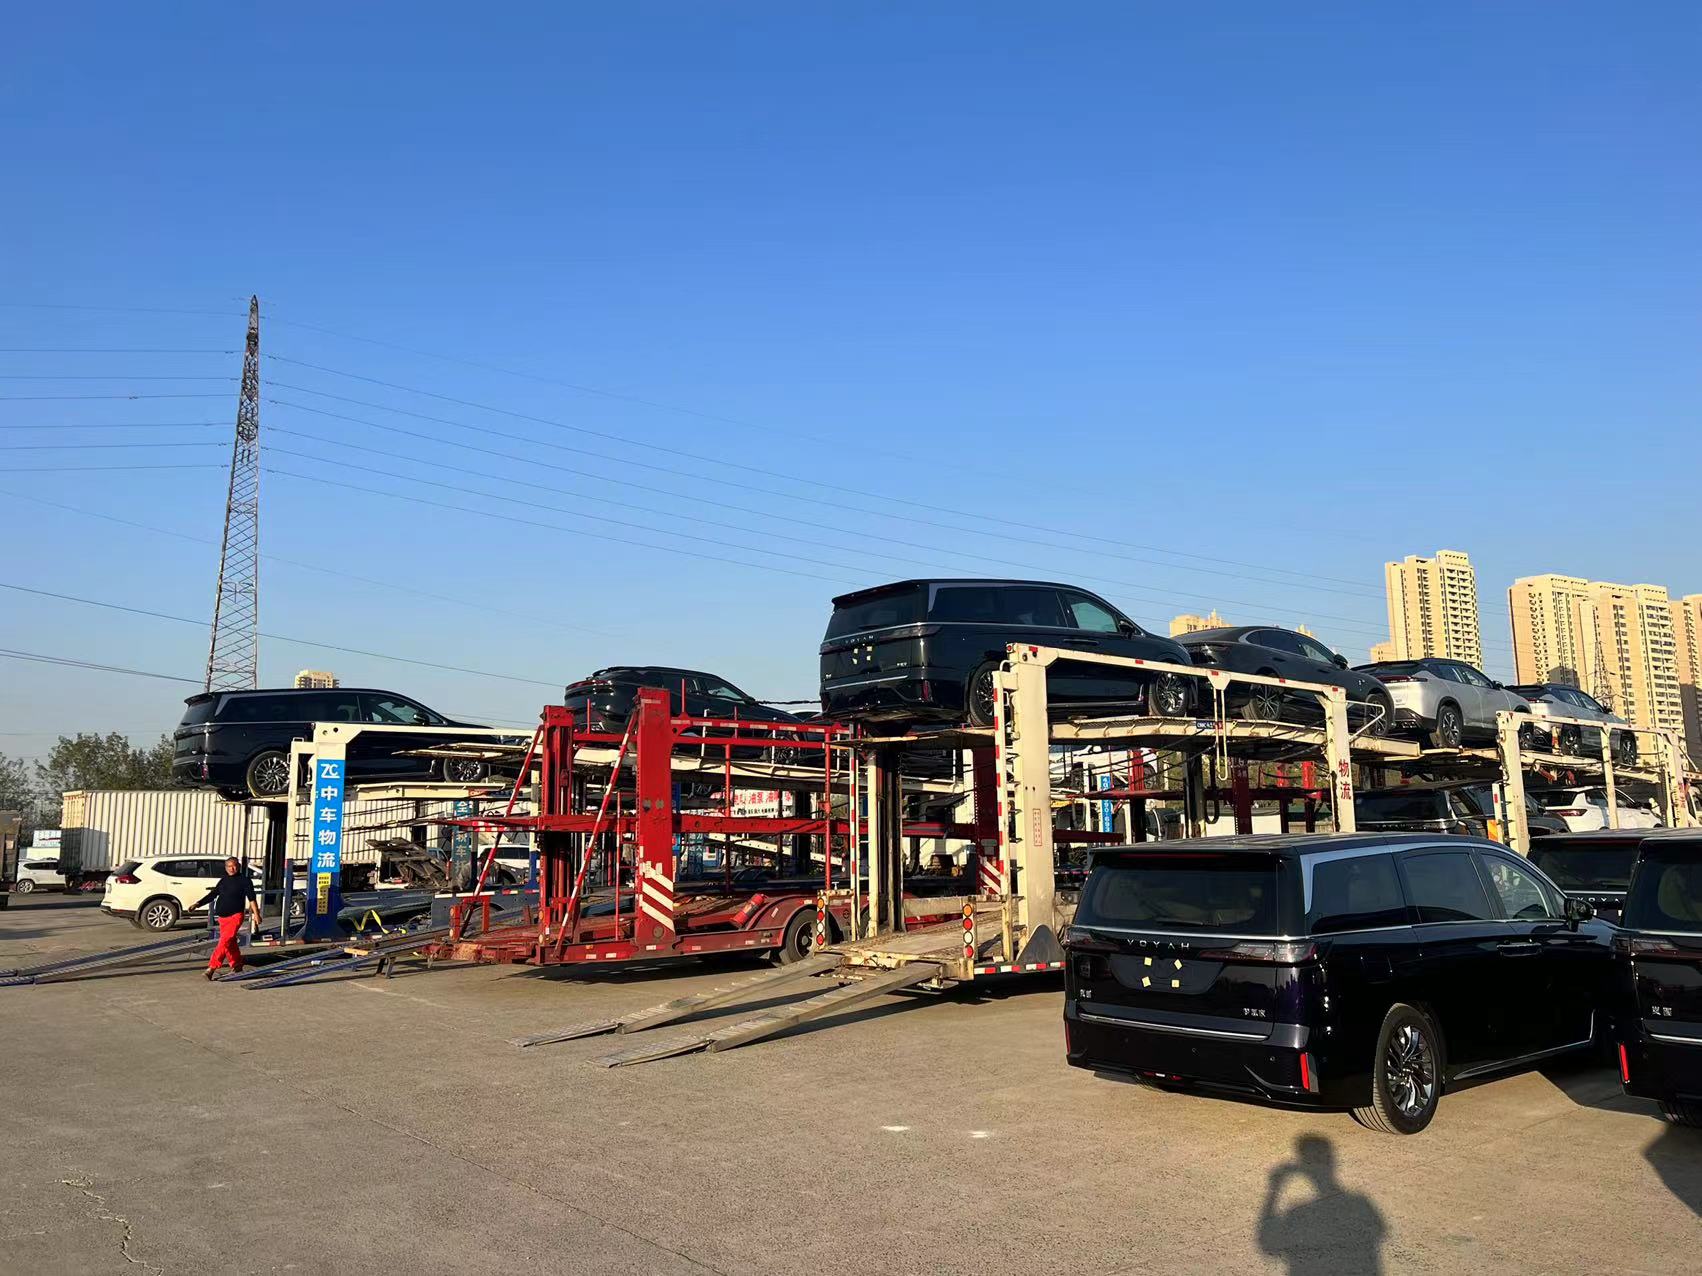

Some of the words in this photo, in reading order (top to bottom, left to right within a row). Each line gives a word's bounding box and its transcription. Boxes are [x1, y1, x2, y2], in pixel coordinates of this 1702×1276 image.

[1339, 759, 1352, 800] 物流
[317, 785, 339, 868] 中车物流
[1126, 939, 1190, 950] VOYAH
